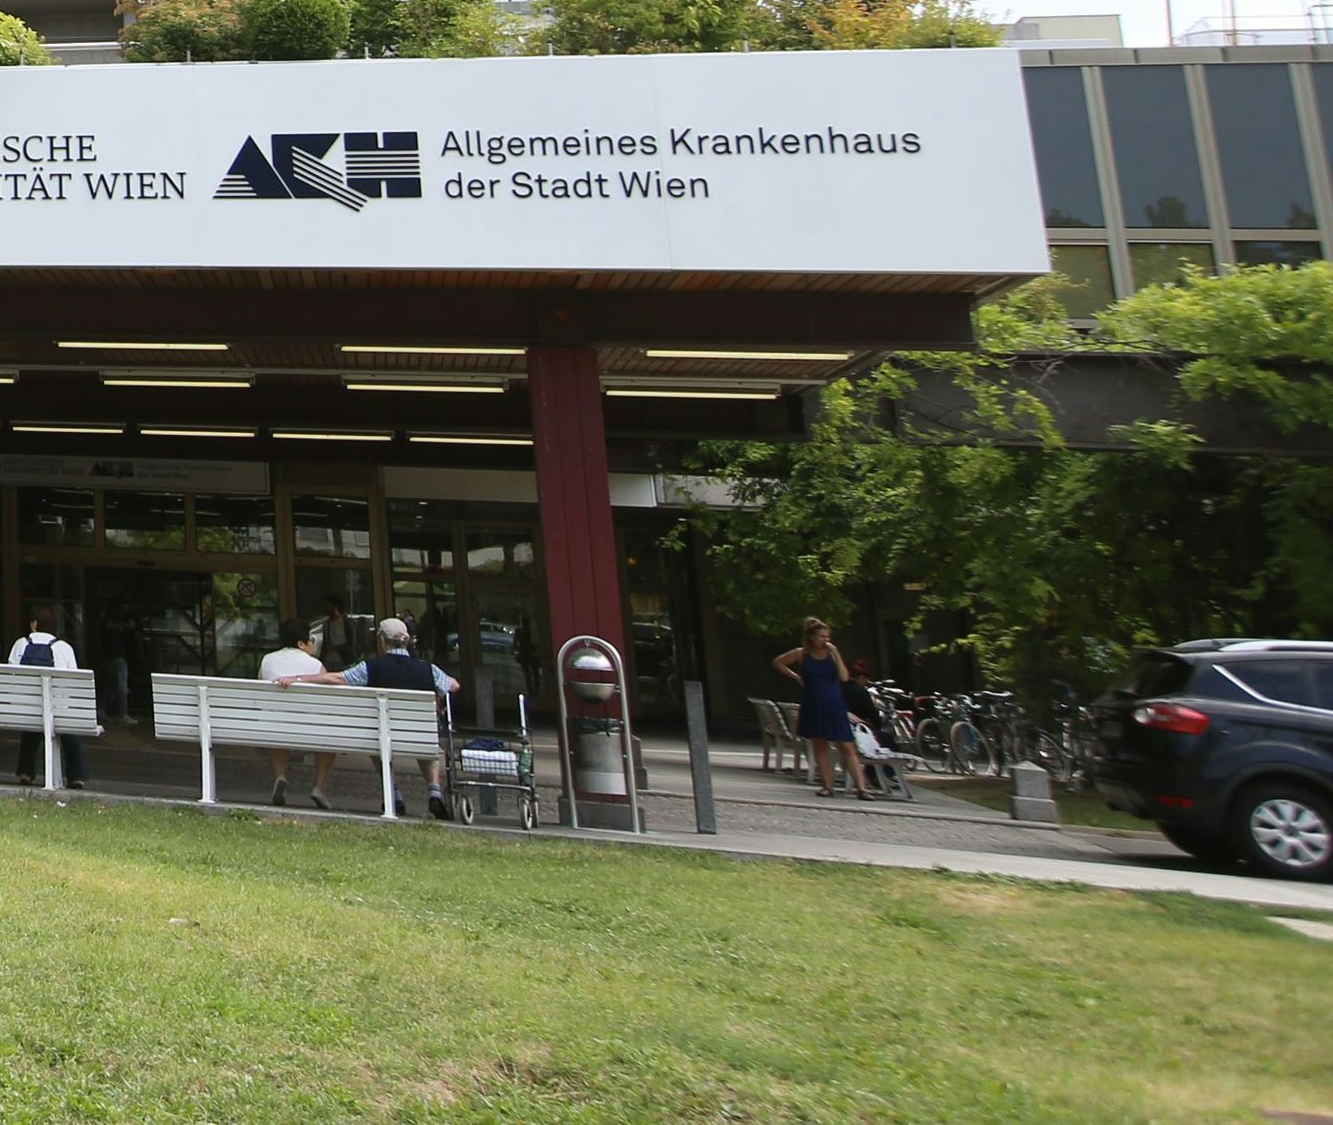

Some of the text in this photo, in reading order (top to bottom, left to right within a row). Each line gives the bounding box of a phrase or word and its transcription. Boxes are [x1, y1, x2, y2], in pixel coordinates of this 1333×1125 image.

[440, 127, 922, 165] Allgemeines Krankenhaus
[85, 171, 187, 200] WIEN
[444, 172, 710, 200] der Stadt Wien
